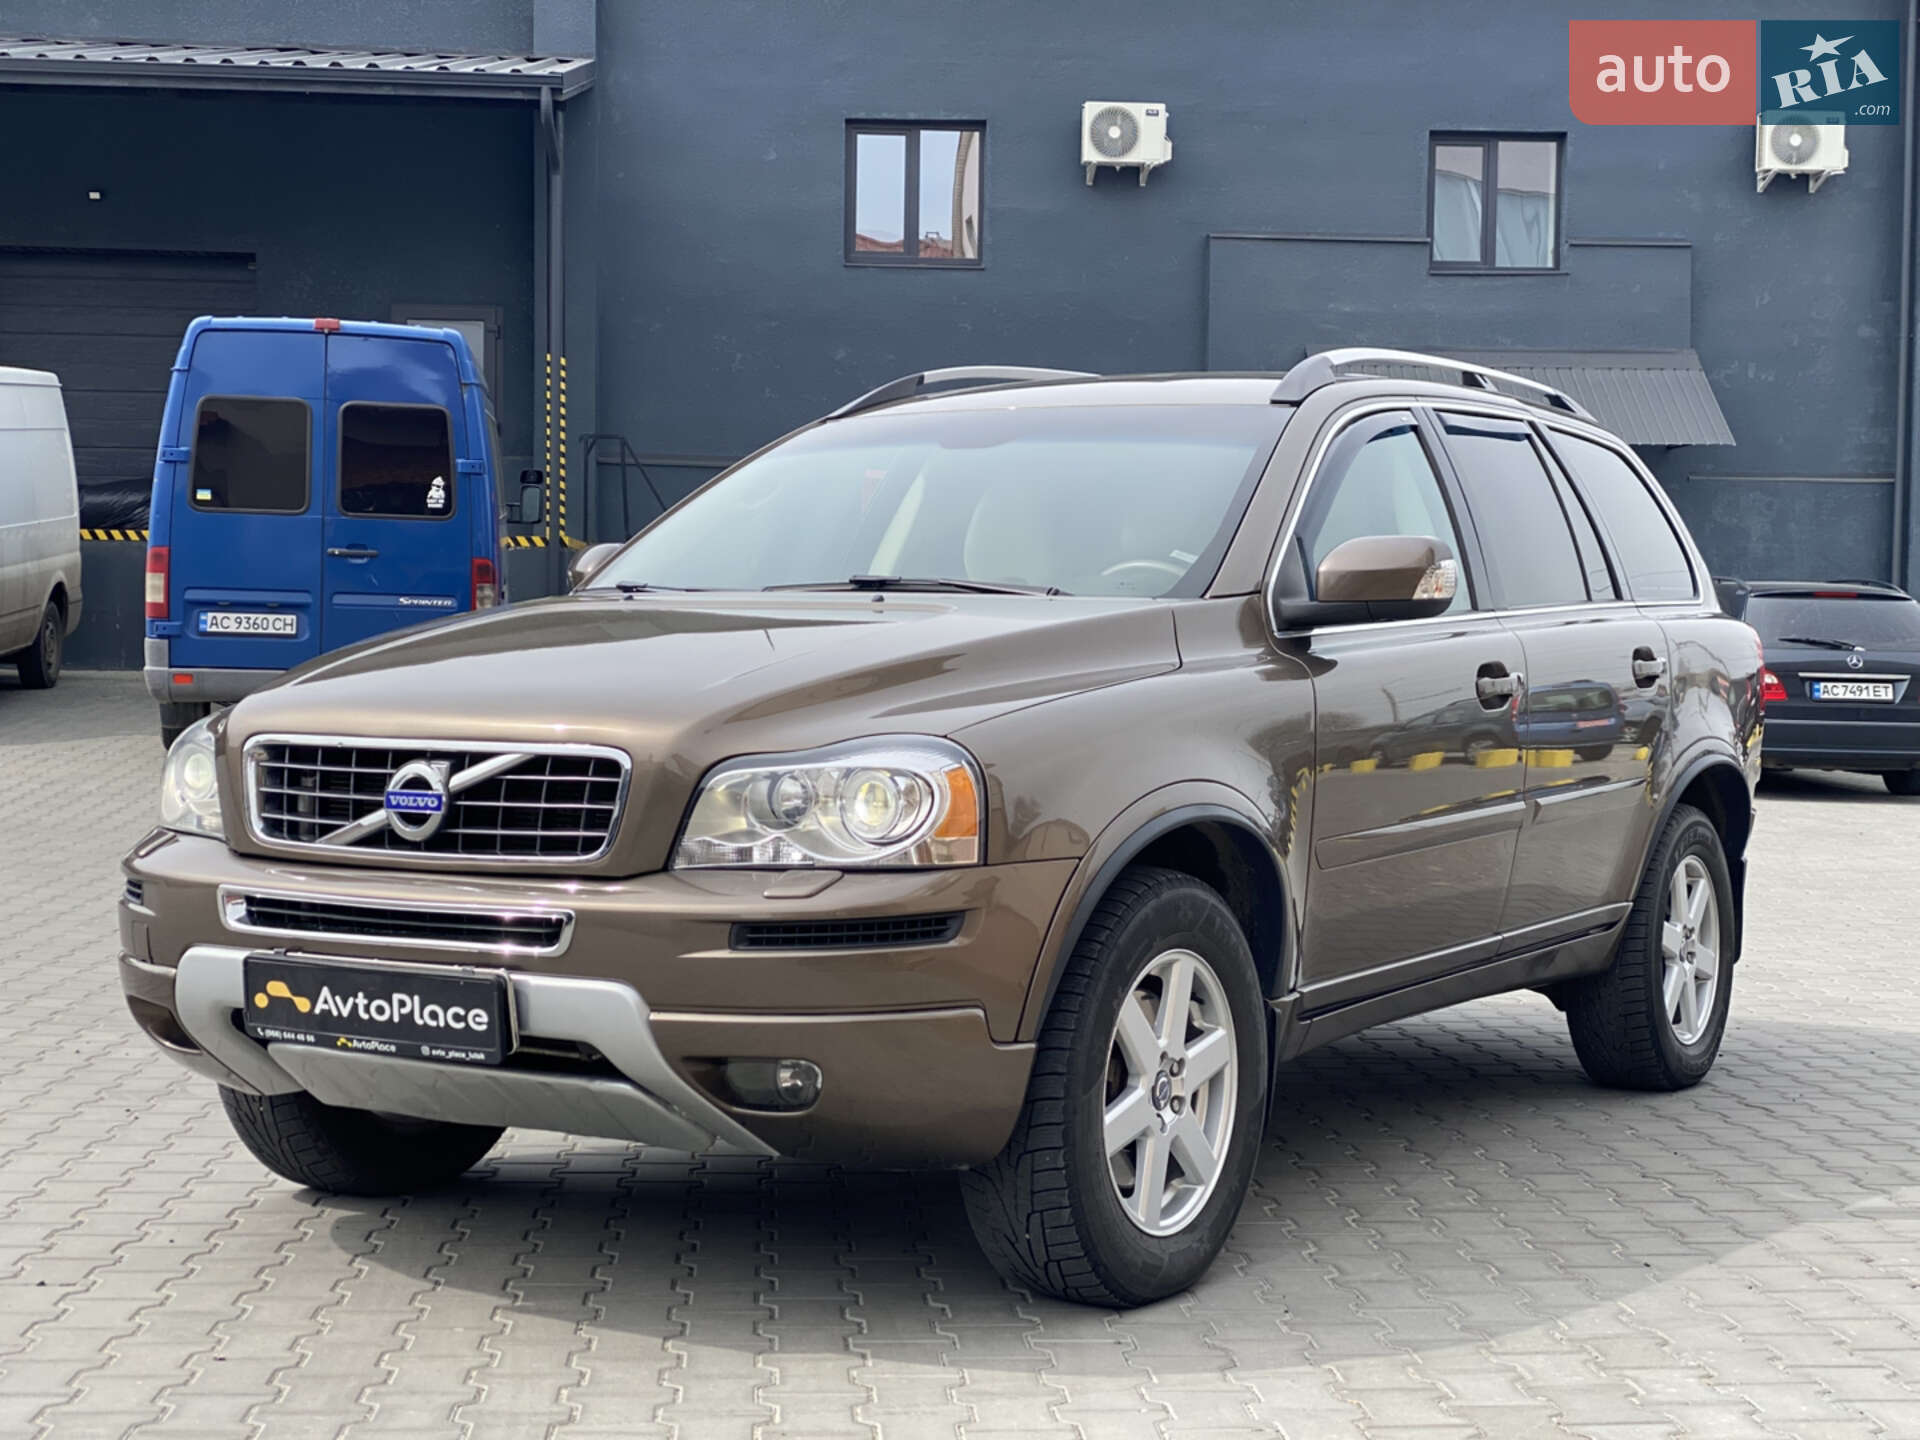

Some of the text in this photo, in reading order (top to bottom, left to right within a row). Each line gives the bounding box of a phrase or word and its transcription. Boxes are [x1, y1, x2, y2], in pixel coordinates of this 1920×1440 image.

[209, 615, 295, 632] AC 9360 CH
[1822, 684, 1890, 697] AC 7491 ET
[389, 795, 438, 807] VOLVO
[313, 985, 489, 1032] AvtoPlace
